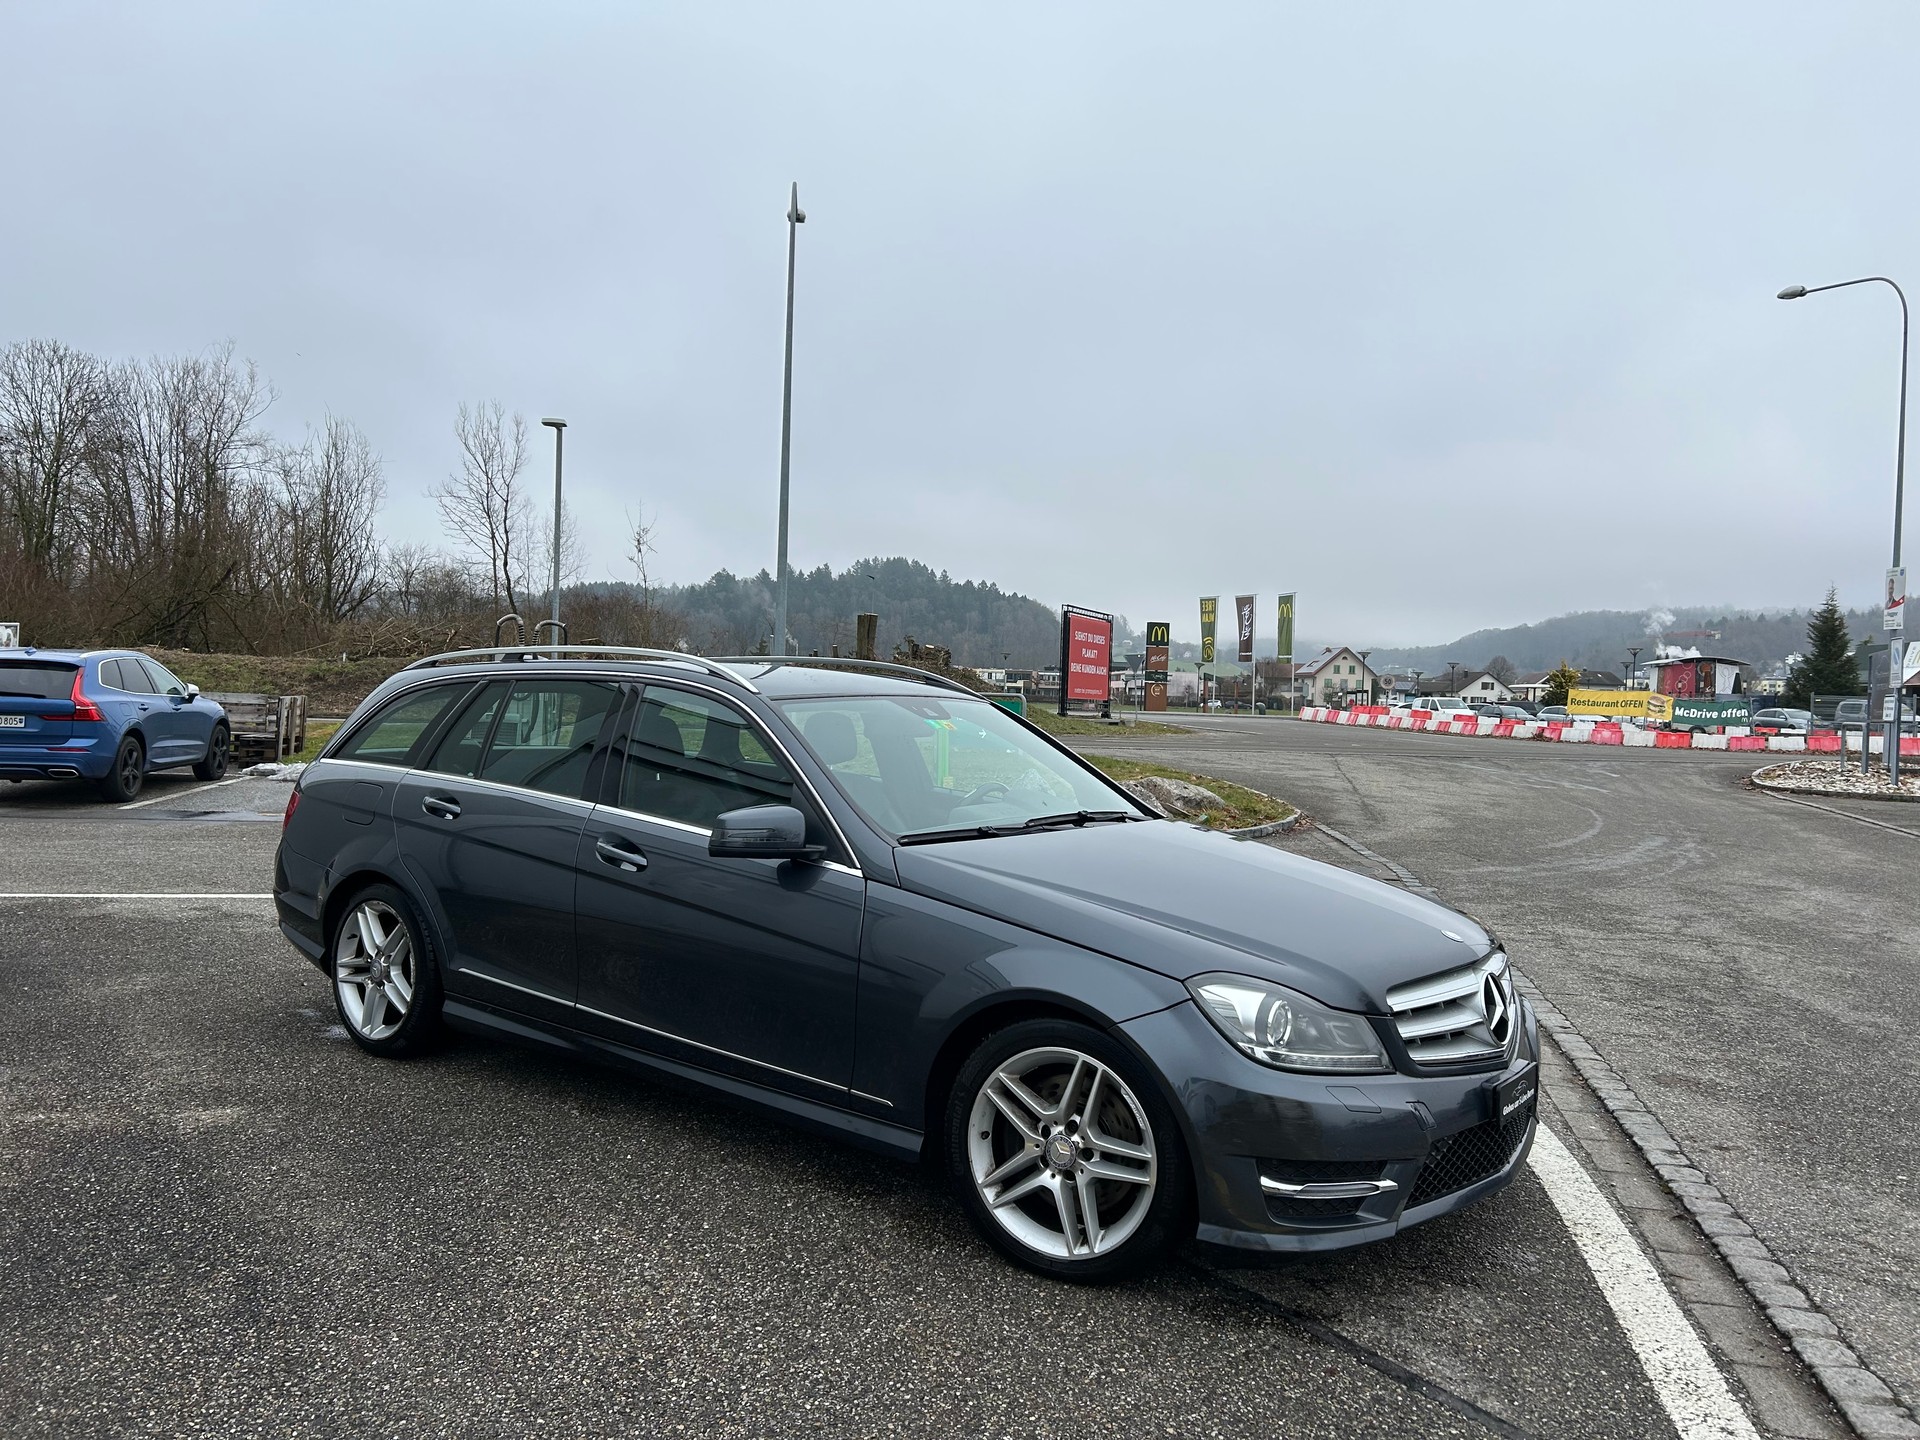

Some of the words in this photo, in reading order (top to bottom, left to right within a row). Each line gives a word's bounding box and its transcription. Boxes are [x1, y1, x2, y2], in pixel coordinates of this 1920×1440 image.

[1087, 633, 1094, 643] DU
[1082, 664, 1096, 674] KUNDEN
[1570, 697, 1619, 708] Restaurant
[1620, 699, 1644, 709] OFFEN
[1674, 706, 1718, 719] McDrive
[1721, 708, 1749, 718] offen
